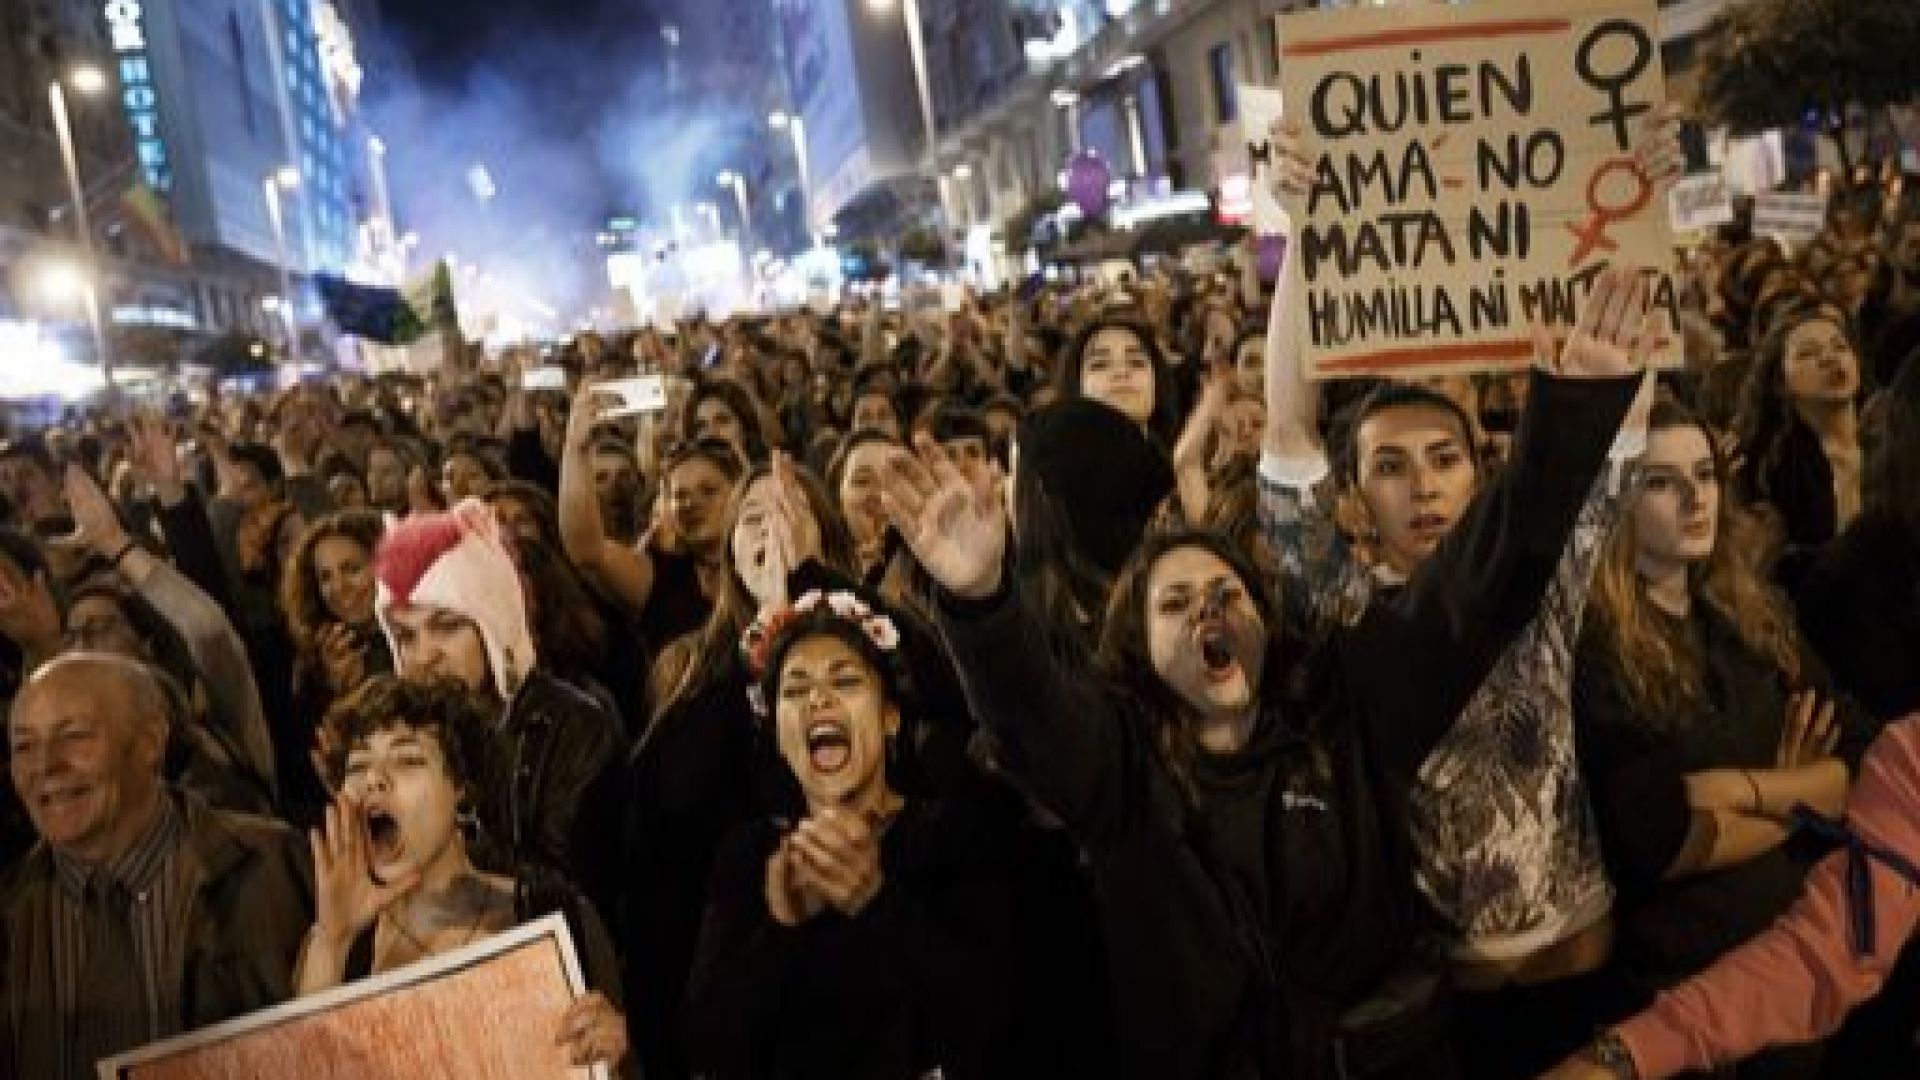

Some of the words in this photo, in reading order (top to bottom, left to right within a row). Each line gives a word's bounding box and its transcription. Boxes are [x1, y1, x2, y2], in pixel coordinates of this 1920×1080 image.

[1477, 128, 1565, 190] NO
[1302, 209, 1456, 281] MATA
[1469, 202, 1531, 259] NI
